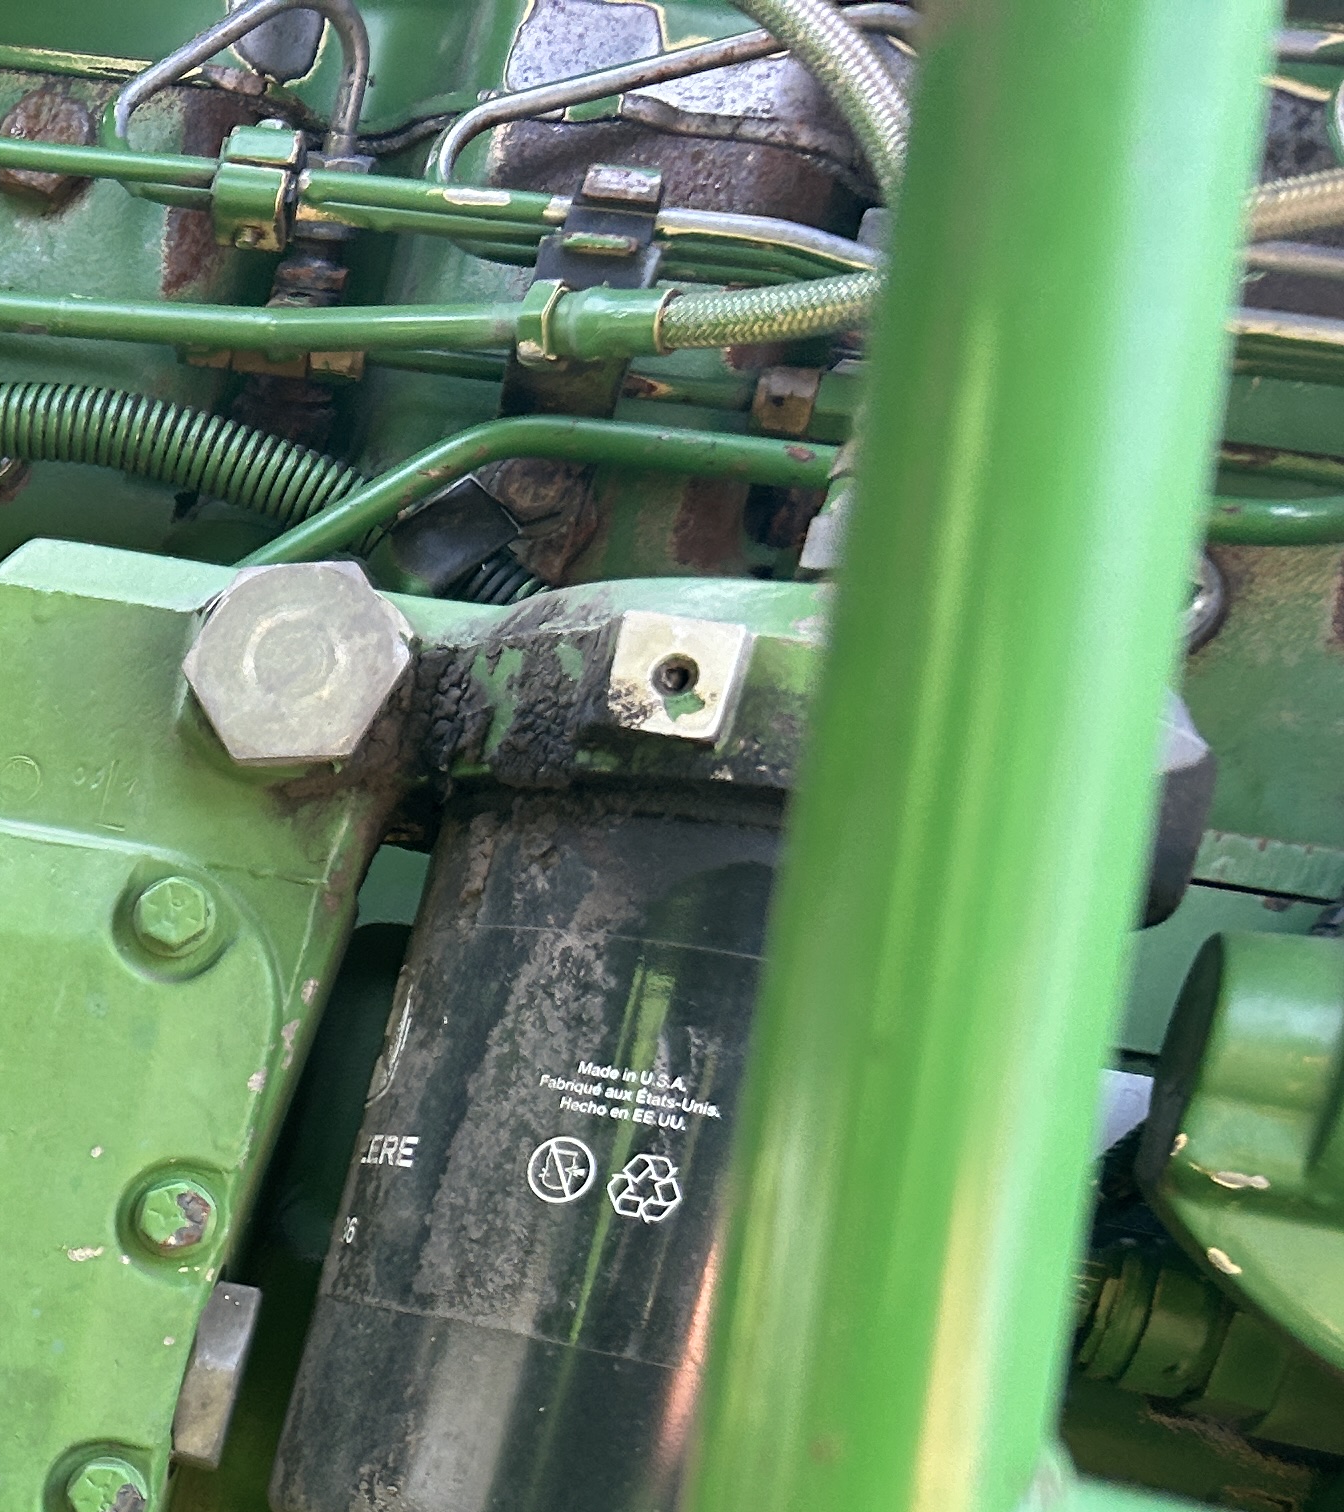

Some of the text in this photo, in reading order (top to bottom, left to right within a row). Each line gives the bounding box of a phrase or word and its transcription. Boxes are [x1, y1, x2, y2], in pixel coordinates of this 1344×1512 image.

[539, 1074, 603, 1096] Fabriqué
[605, 1087, 632, 1102] aux
[578, 1061, 687, 1092] Made in U.S.A.
[560, 1096, 607, 1116] Hecho
[610, 1107, 629, 1120] en
